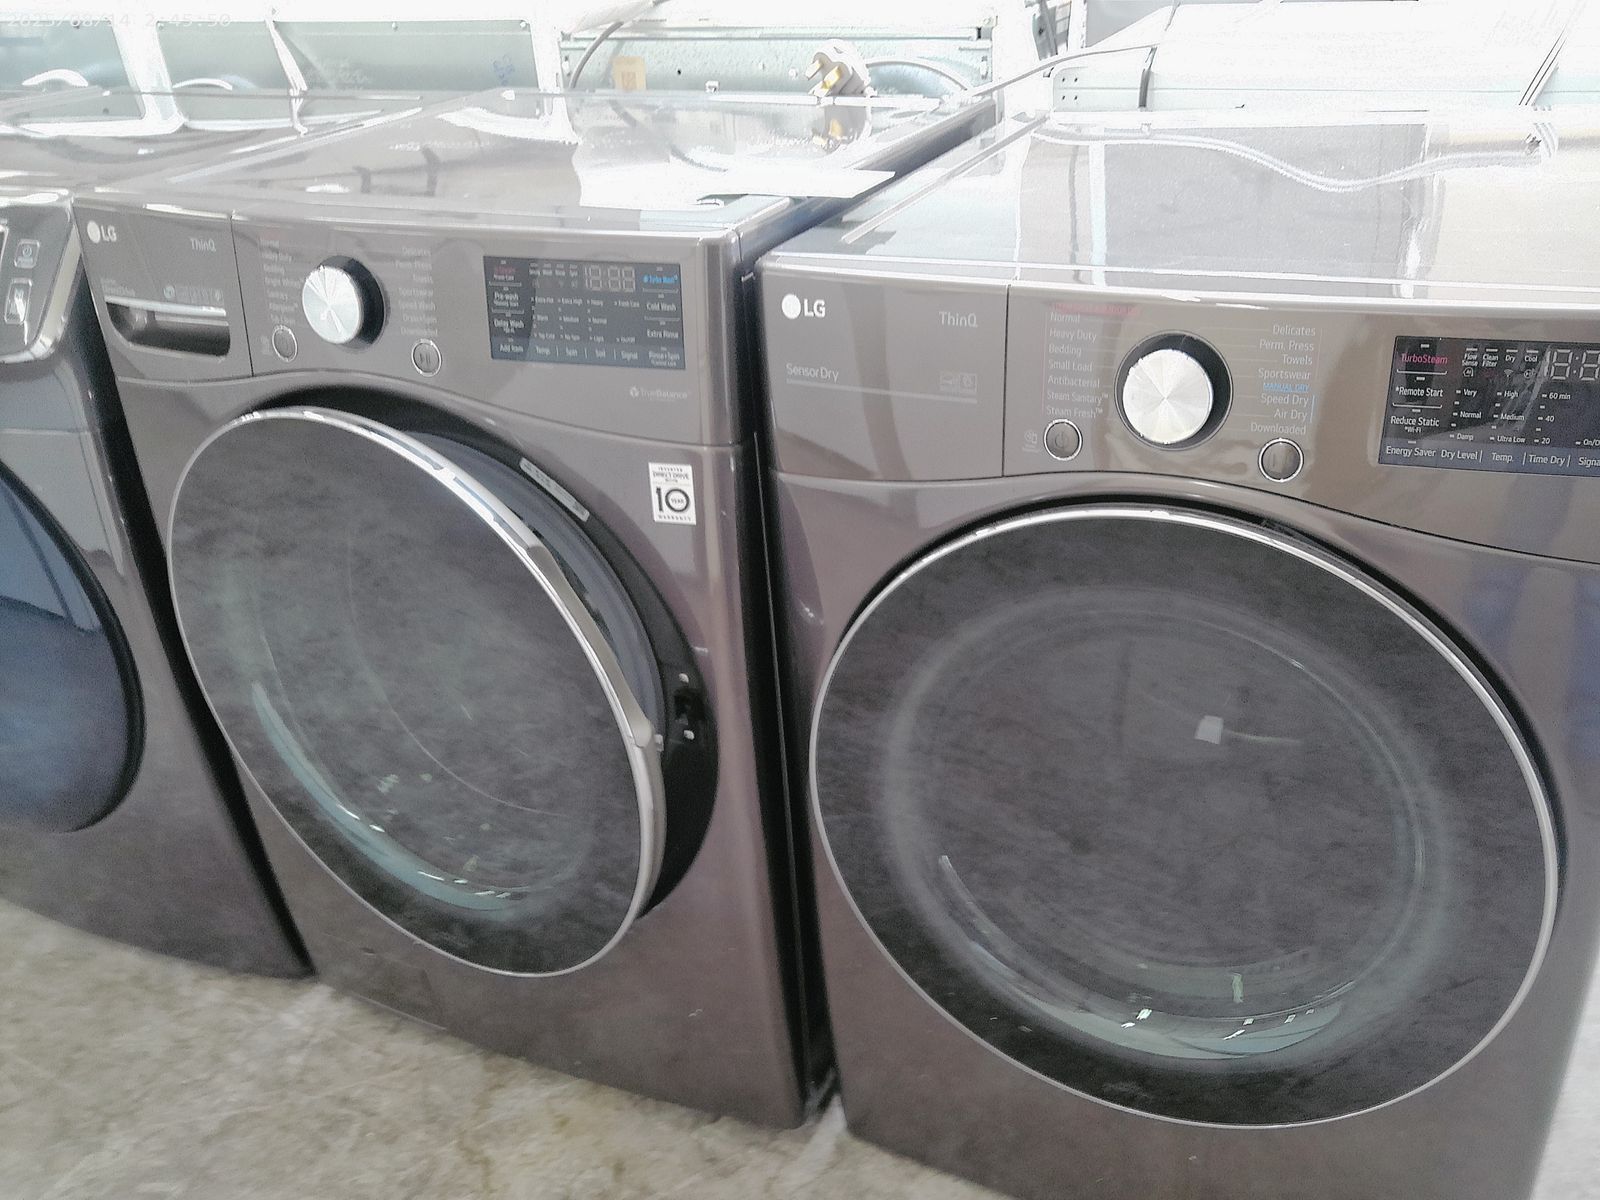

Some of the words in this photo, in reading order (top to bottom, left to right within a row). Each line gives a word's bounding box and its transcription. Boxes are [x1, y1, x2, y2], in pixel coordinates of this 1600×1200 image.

[101, 225, 117, 242] LG
[189, 237, 217, 252] ThinQ
[803, 298, 826, 318] LG
[939, 311, 978, 328] ThinQ
[1050, 312, 1081, 323] Normal
[1049, 328, 1075, 341] Heavy
[1076, 330, 1097, 344] Duty
[1272, 324, 1316, 337] Delicates
[1049, 344, 1082, 358] Bedding
[1288, 340, 1315, 352] Press
[1282, 354, 1313, 365] Towels
[1401, 352, 1448, 365] TurboSteam
[1505, 354, 1516, 363] Dry
[1049, 360, 1070, 371] Small
[1072, 361, 1093, 372] Load
[1258, 367, 1311, 380] Sportswear
[1048, 375, 1100, 388] Antibacterial
[1047, 391, 1070, 401] Steam
[1425, 387, 1444, 397] Start
[1463, 389, 1477, 398] Very
[1504, 391, 1518, 399] High
[1261, 393, 1290, 405] Speed
[1292, 395, 1309, 407] Dry
[1046, 406, 1072, 416] Steam
[1273, 408, 1288, 419] Air
[1290, 409, 1308, 422] Dry
[1460, 410, 1481, 419] Normal
[1500, 413, 1525, 421] Medium
[1390, 415, 1416, 425] Reduce
[1417, 417, 1440, 427] Static
[1250, 422, 1306, 435] Downloaded
[1456, 433, 1474, 441] Damp
[1386, 445, 1412, 458] Energy
[1413, 446, 1436, 457] Saver
[1441, 449, 1455, 460] Dry
[1457, 450, 1478, 460] Level
[1529, 454, 1548, 463] Time
[1550, 455, 1565, 467] Dry
[655, 486, 690, 513] 10
